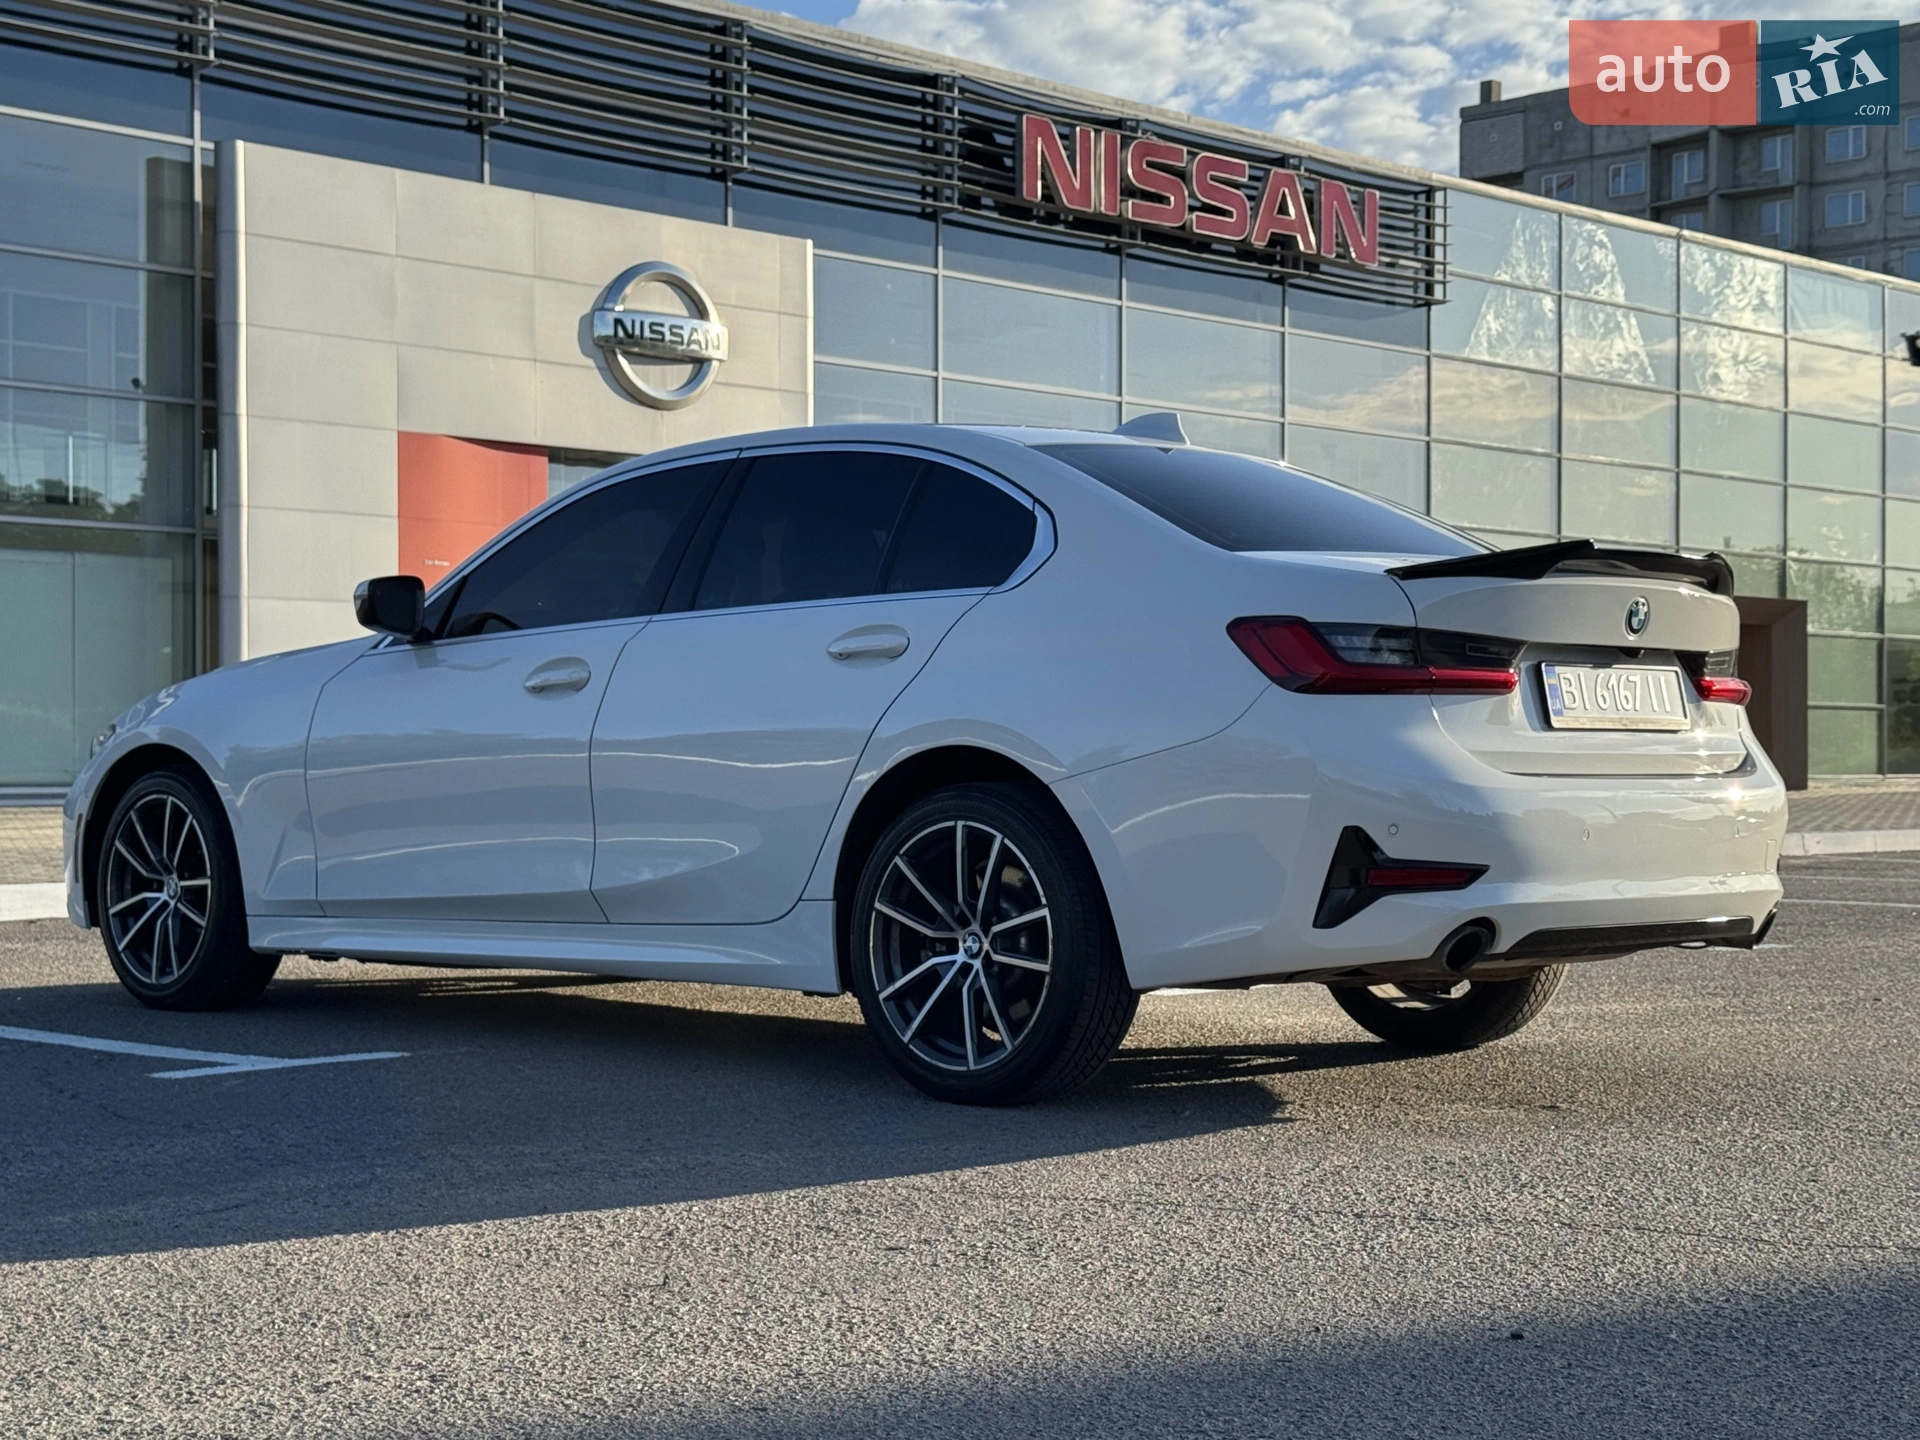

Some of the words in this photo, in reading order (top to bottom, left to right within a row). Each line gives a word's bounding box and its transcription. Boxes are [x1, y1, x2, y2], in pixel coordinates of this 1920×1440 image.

[1021, 113, 1381, 268] NISSAN
[613, 317, 721, 352] NISSAN
[1558, 672, 1590, 711] BI
[1594, 672, 1642, 712] 6167
[1646, 674, 1672, 713] II
